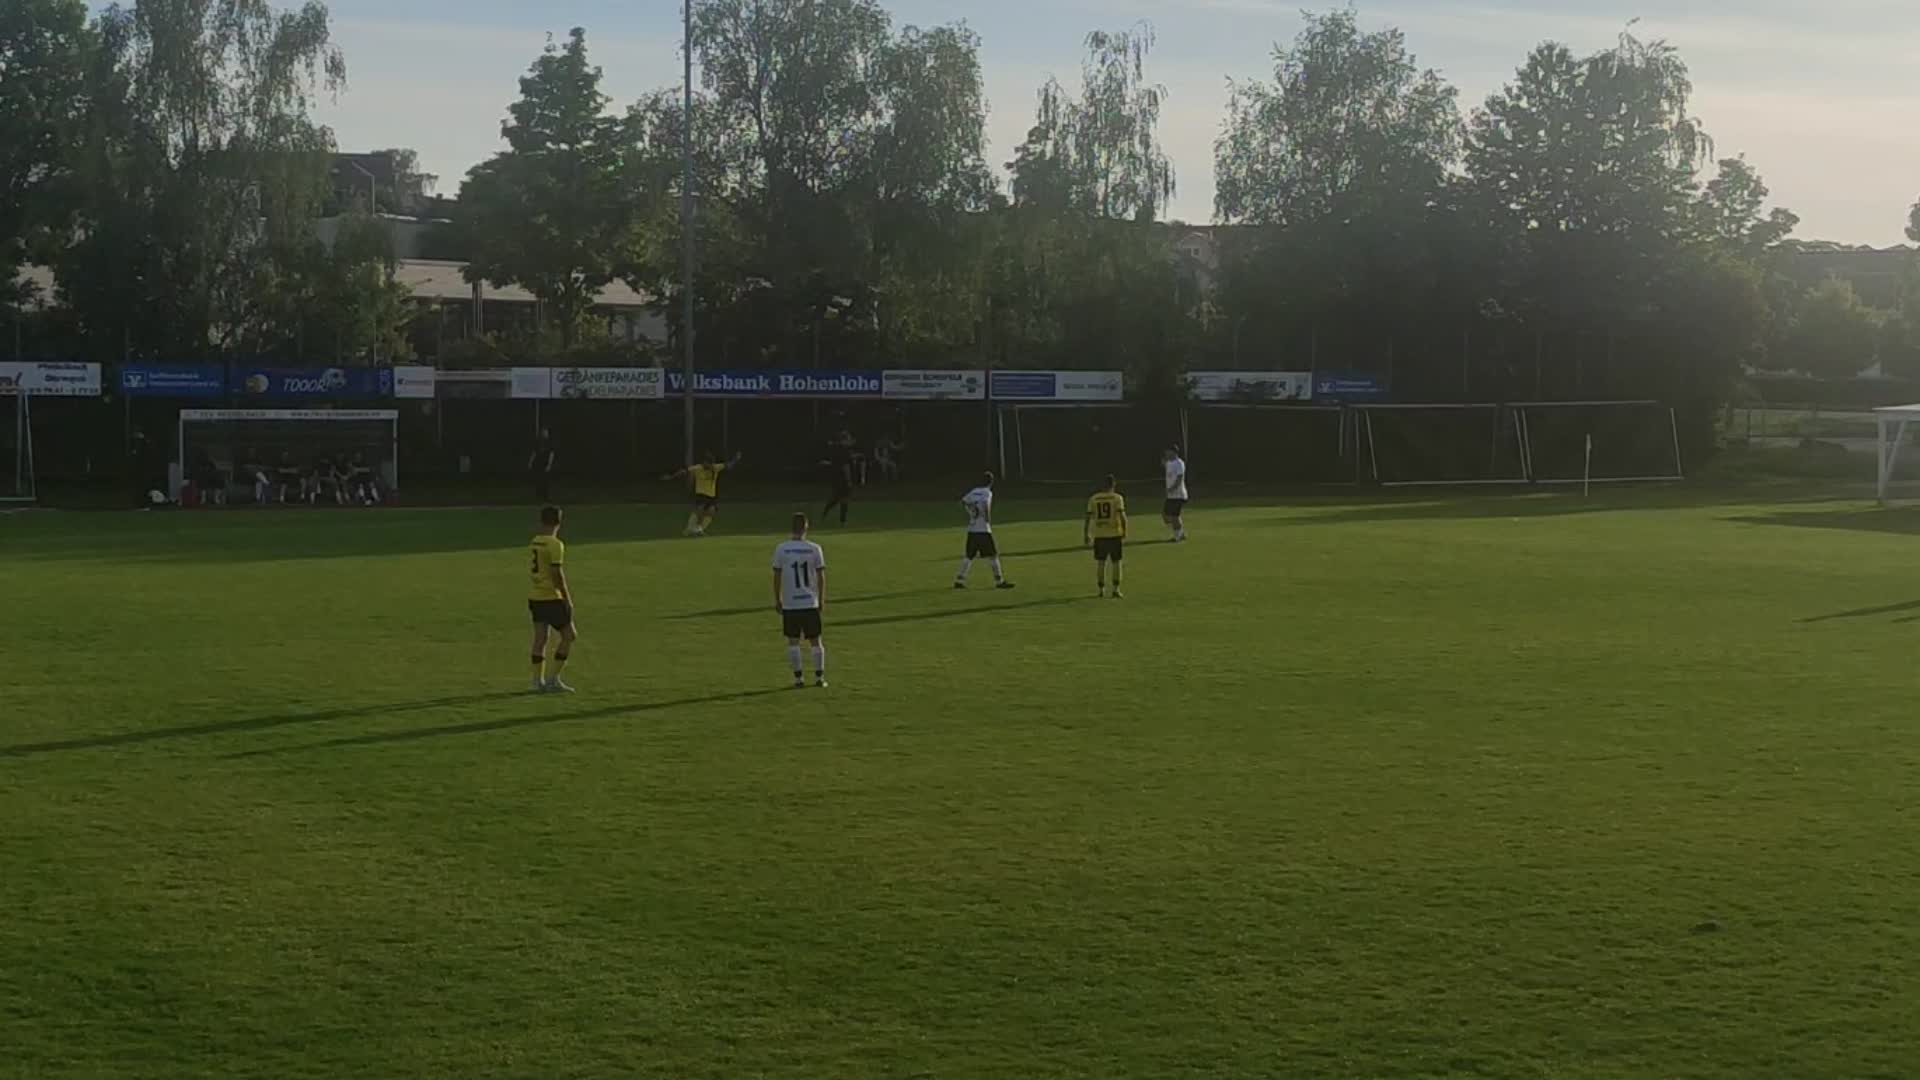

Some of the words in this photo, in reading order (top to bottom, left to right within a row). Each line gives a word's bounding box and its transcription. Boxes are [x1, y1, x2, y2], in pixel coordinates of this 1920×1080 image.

[779, 374, 880, 391] Hohenlohe
[1097, 502, 1111, 519] 19
[791, 561, 810, 588] 11
